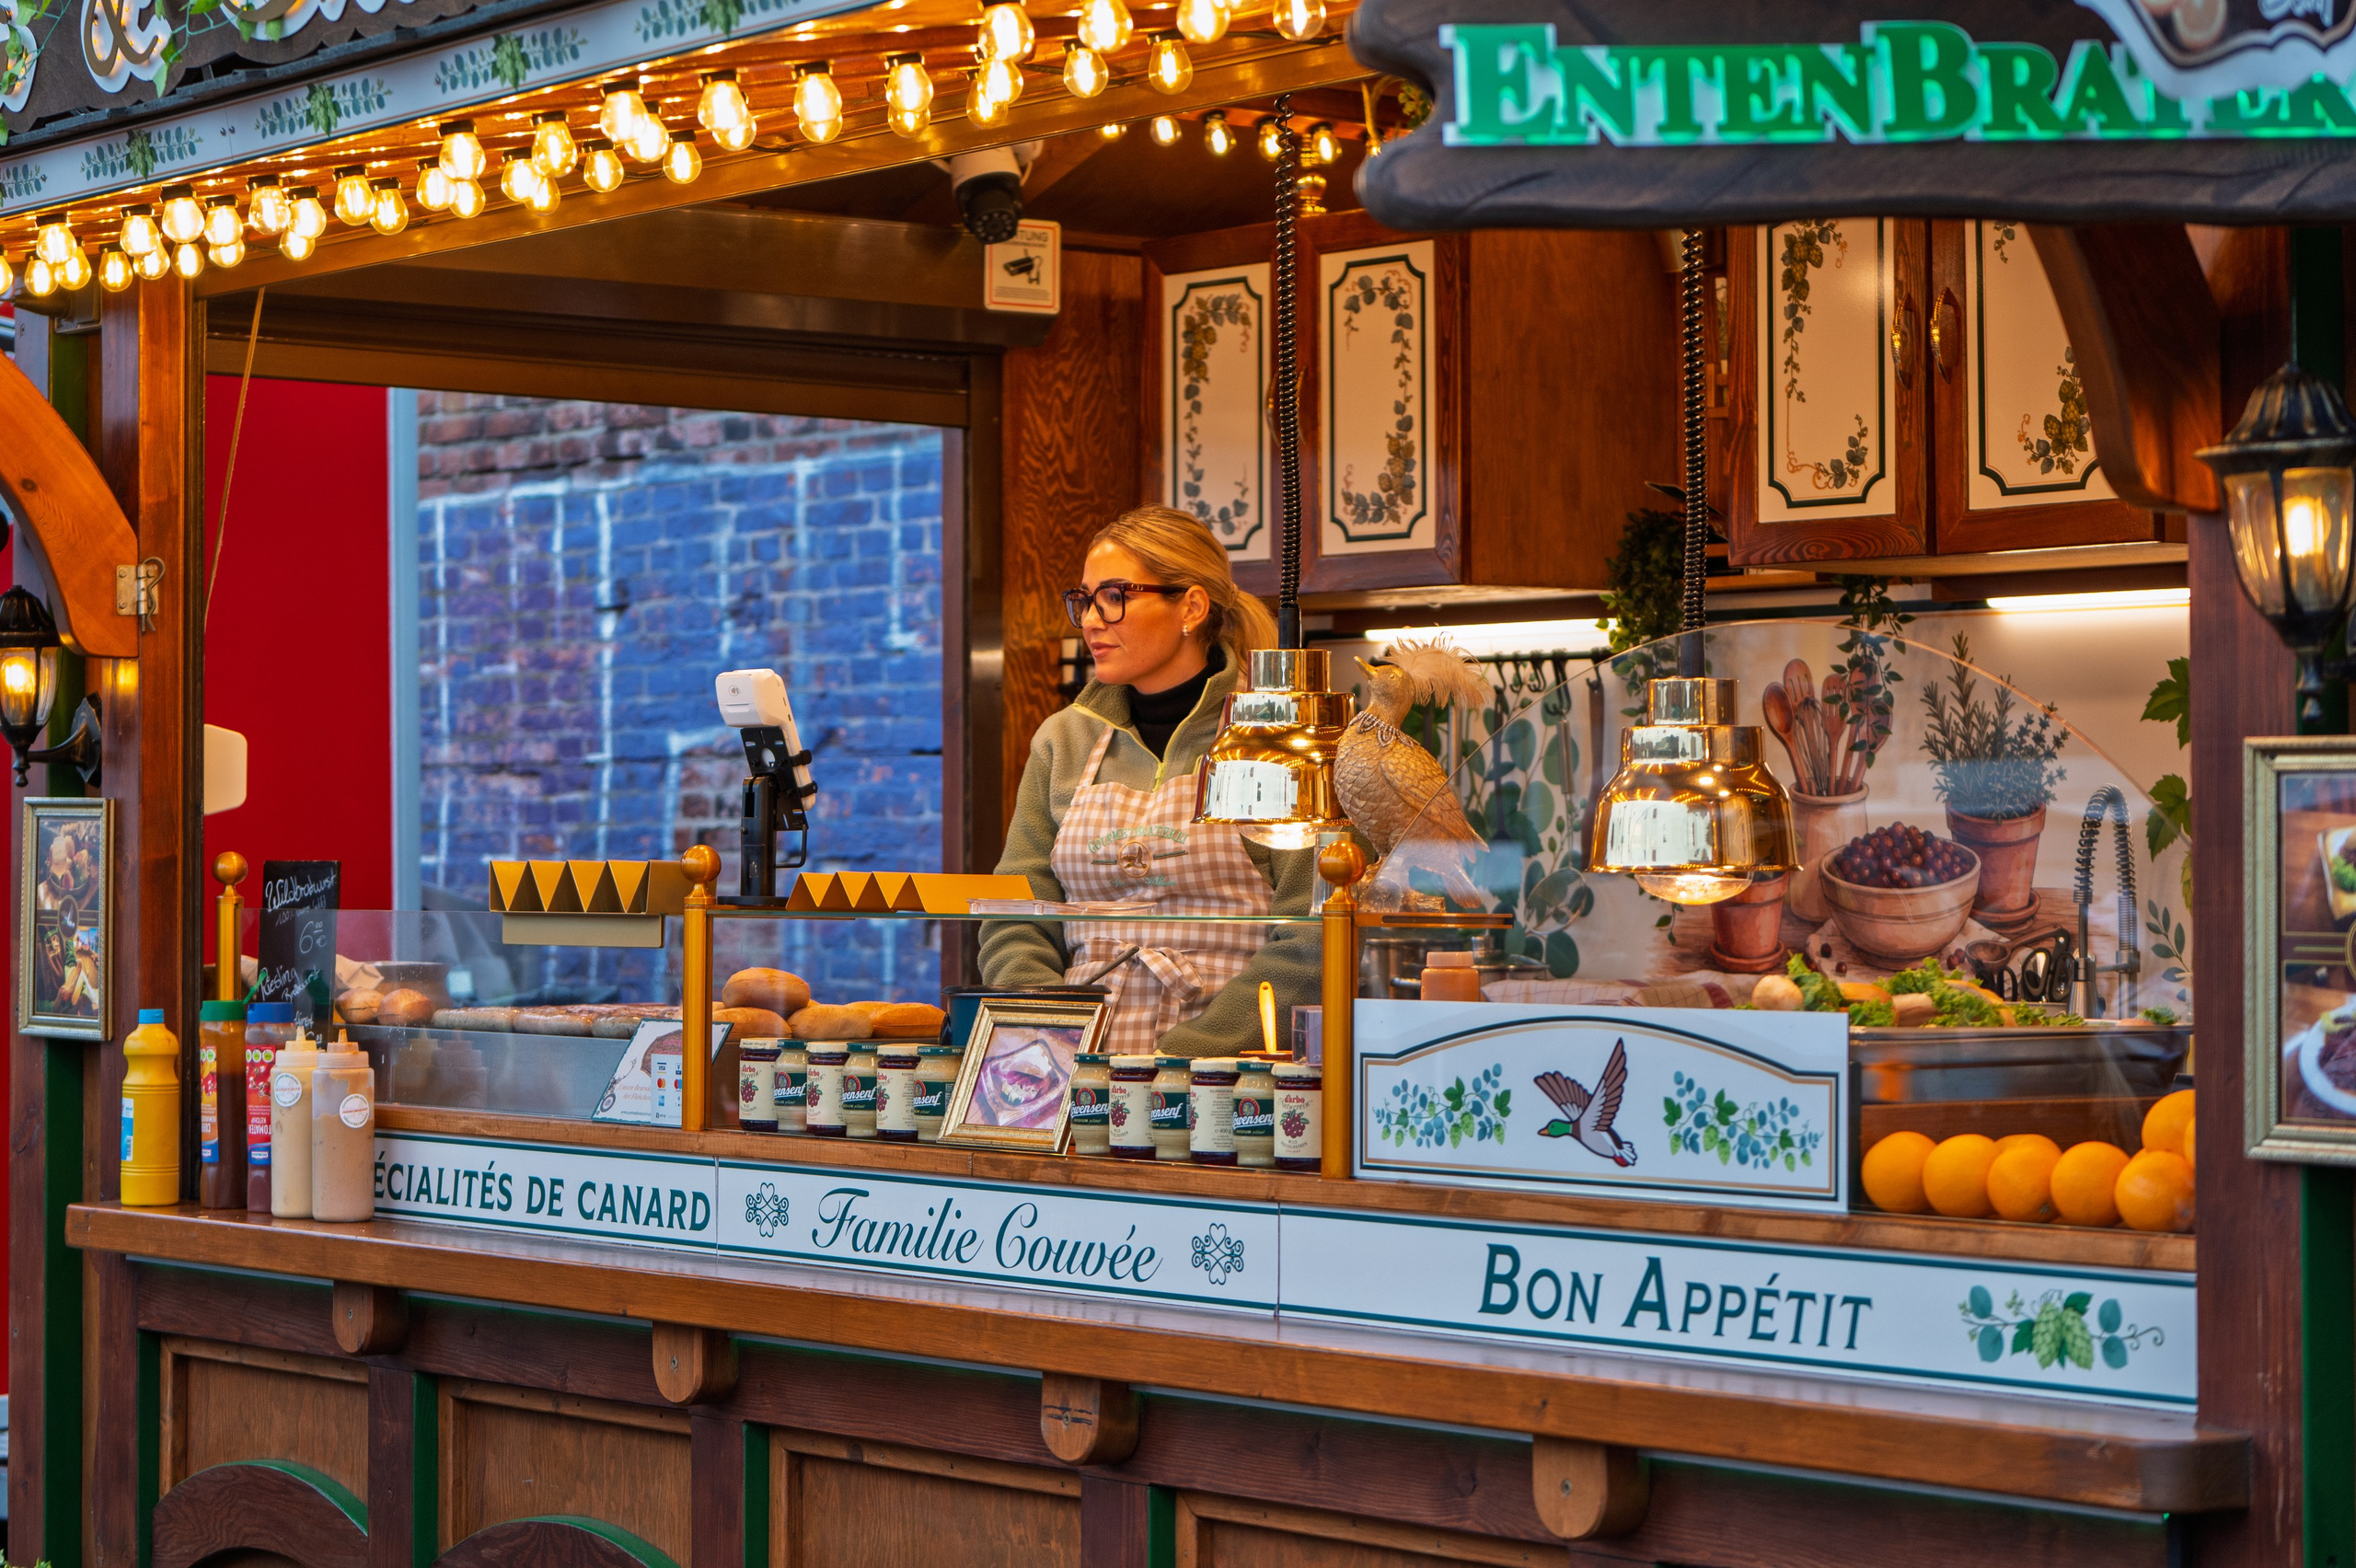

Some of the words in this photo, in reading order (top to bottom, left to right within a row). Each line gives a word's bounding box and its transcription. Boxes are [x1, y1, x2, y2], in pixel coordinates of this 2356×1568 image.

[1019, 229, 1048, 242] TUNG
[773, 1082, 807, 1100] wensenf
[841, 1087, 877, 1101] wensenf
[1151, 1103, 1184, 1120] ensenf
[248, 1124, 271, 1135] TOMATEN
[374, 1150, 514, 1213] ÉCIALITÉS
[525, 1175, 565, 1217] DE
[577, 1181, 711, 1232] CANARD
[811, 1186, 985, 1264] Familie
[994, 1201, 1163, 1283] Couvée
[1477, 1242, 1605, 1325] BON
[1621, 1255, 1874, 1350] APPÉTIT
